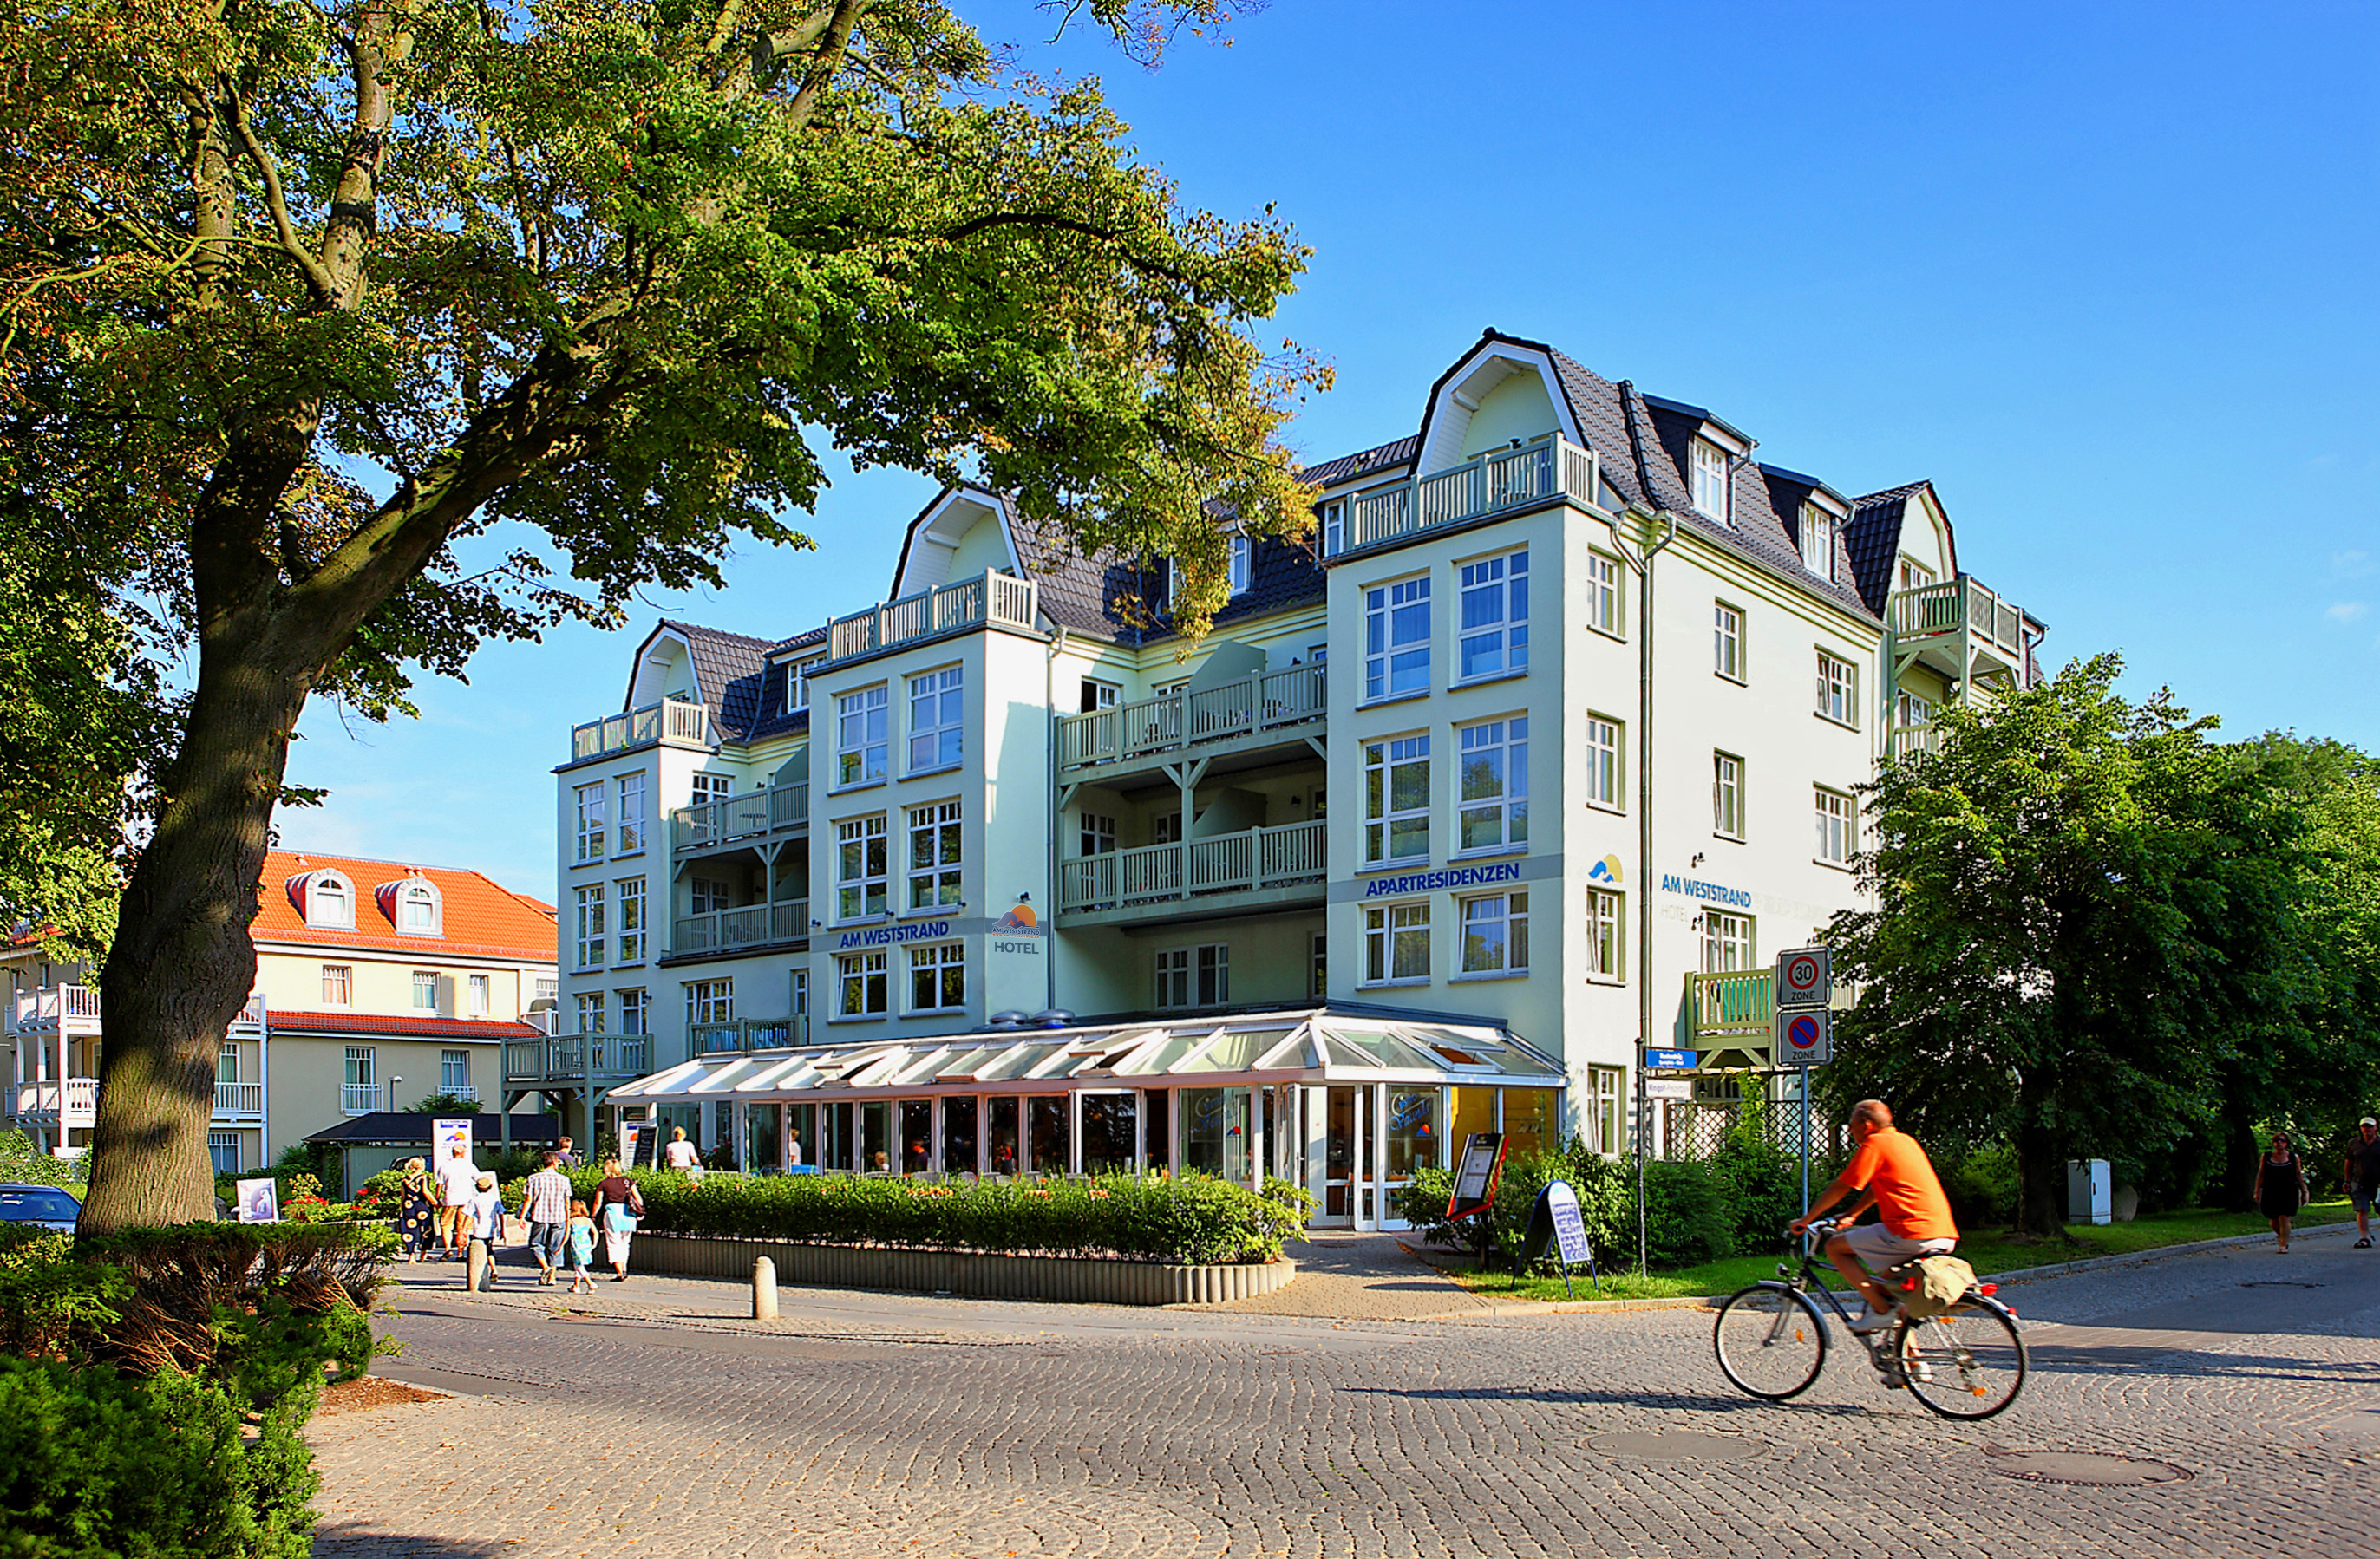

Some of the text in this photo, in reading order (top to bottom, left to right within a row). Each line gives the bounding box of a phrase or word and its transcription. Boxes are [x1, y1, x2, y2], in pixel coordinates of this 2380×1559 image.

[1365, 863, 1520, 897] APARTRESIDENZEN
[1661, 874, 1752, 909] AM WESTSTRAND
[840, 921, 949, 949] AM WESTSTRAND
[994, 941, 1040, 955] HOTEL
[1795, 964, 1813, 982] 30
[1790, 990, 1815, 1001] ZONE
[1791, 1050, 1816, 1060] ZONE
